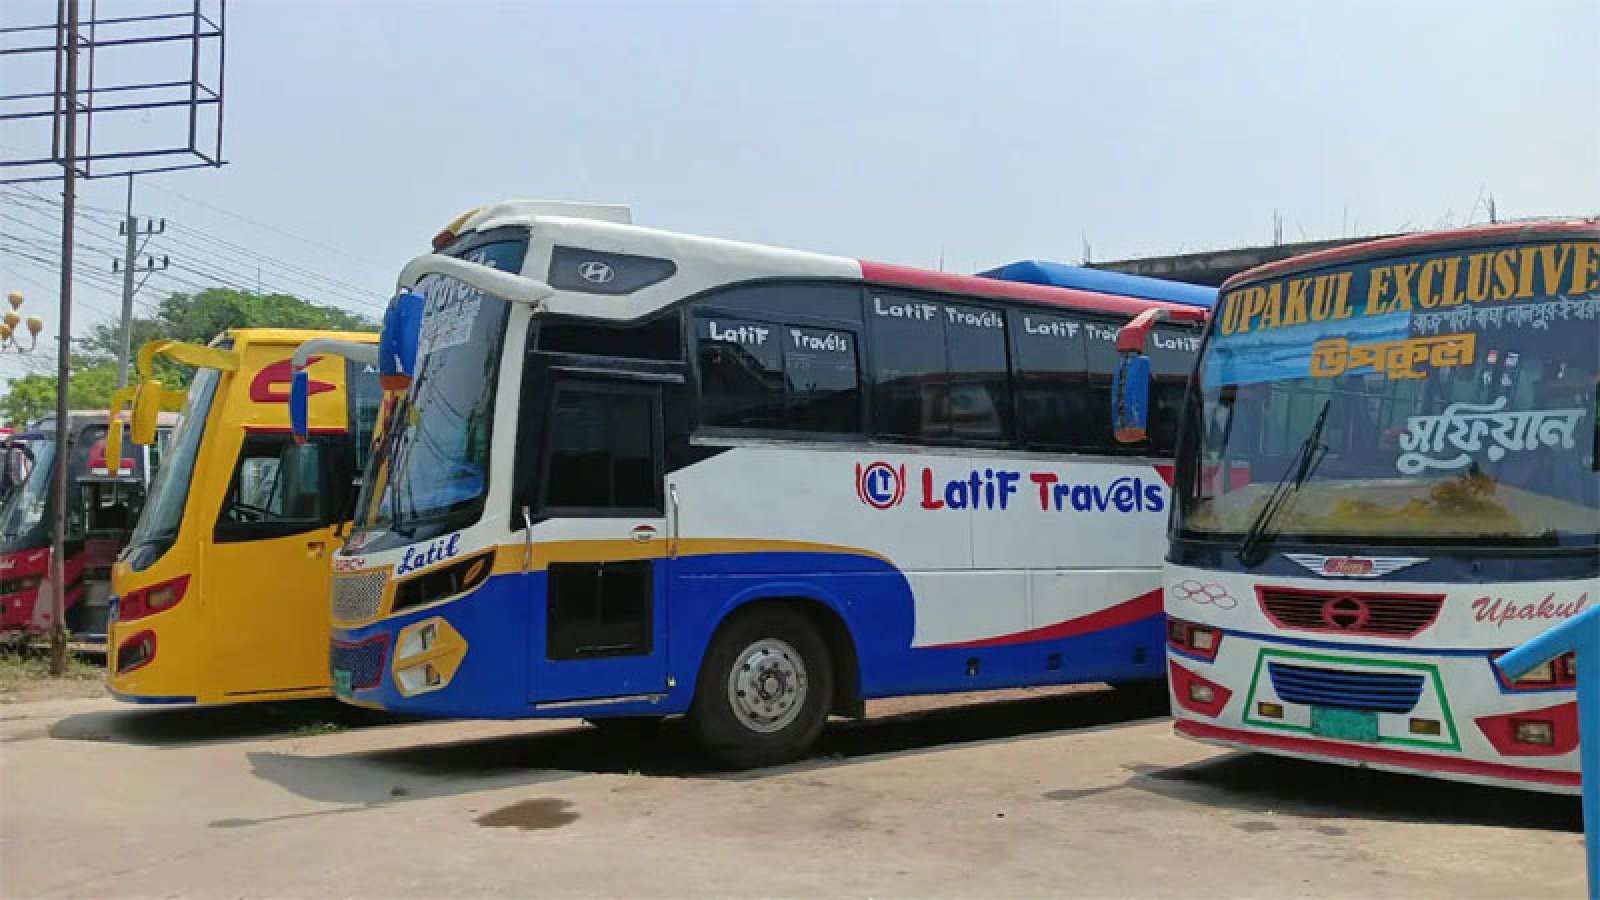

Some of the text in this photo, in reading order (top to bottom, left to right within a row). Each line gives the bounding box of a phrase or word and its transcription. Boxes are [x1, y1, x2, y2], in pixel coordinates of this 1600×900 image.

[1221, 242, 1600, 336] UPAKUL EXCLUSIVE
[945, 306, 1005, 329] Travels
[1085, 323, 1119, 342] Trav
[790, 329, 847, 352] Travels
[1029, 472, 1165, 513] Travels
[1471, 591, 1588, 629] Upakul
